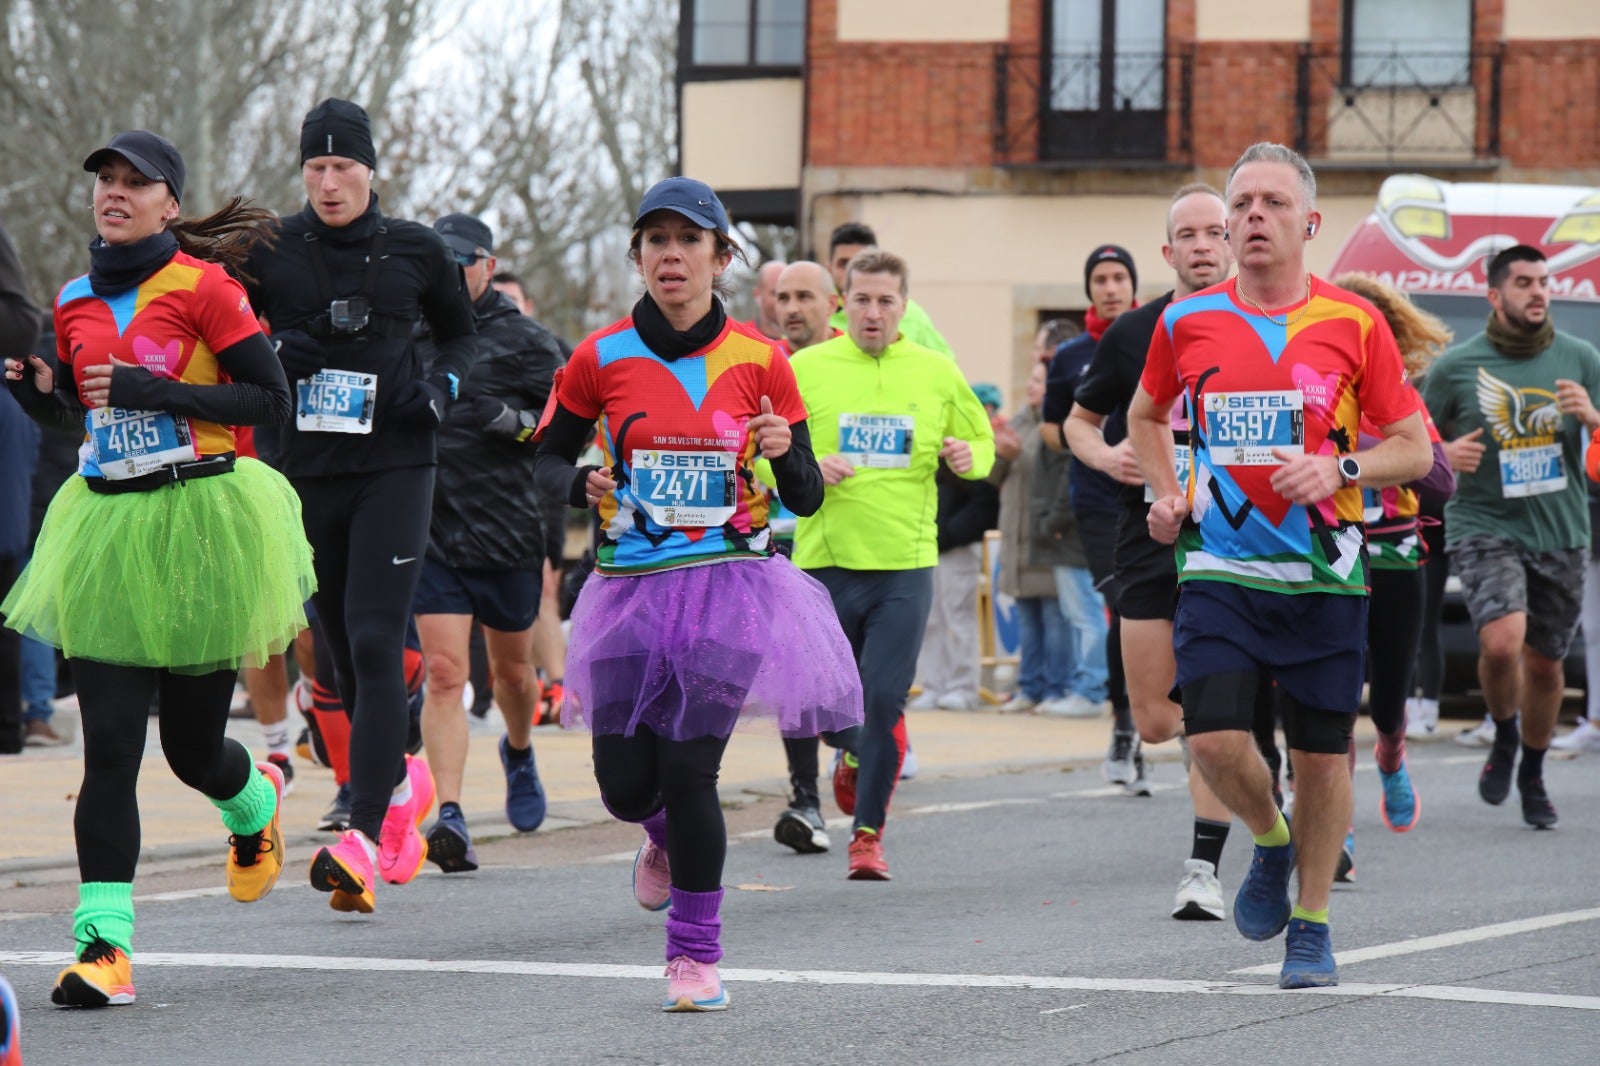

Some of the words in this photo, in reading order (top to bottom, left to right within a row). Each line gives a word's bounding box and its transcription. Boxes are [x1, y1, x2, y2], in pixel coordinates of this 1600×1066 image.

[144, 354, 166, 362] XXXIX
[315, 373, 365, 386] SETEL
[1305, 385, 1327, 396] XXXIX
[307, 385, 351, 412] 4153
[1228, 396, 1293, 408] SETEL
[859, 416, 905, 427] SETEL
[1216, 411, 1278, 441] 3597
[108, 417, 160, 453] 4135
[653, 435, 667, 444] SAN
[668, 436, 702, 446] SILVESTRE
[848, 428, 896, 451] 4373
[661, 455, 726, 468] SETEL
[1509, 458, 1553, 482] 3807
[650, 470, 708, 501] 2471
